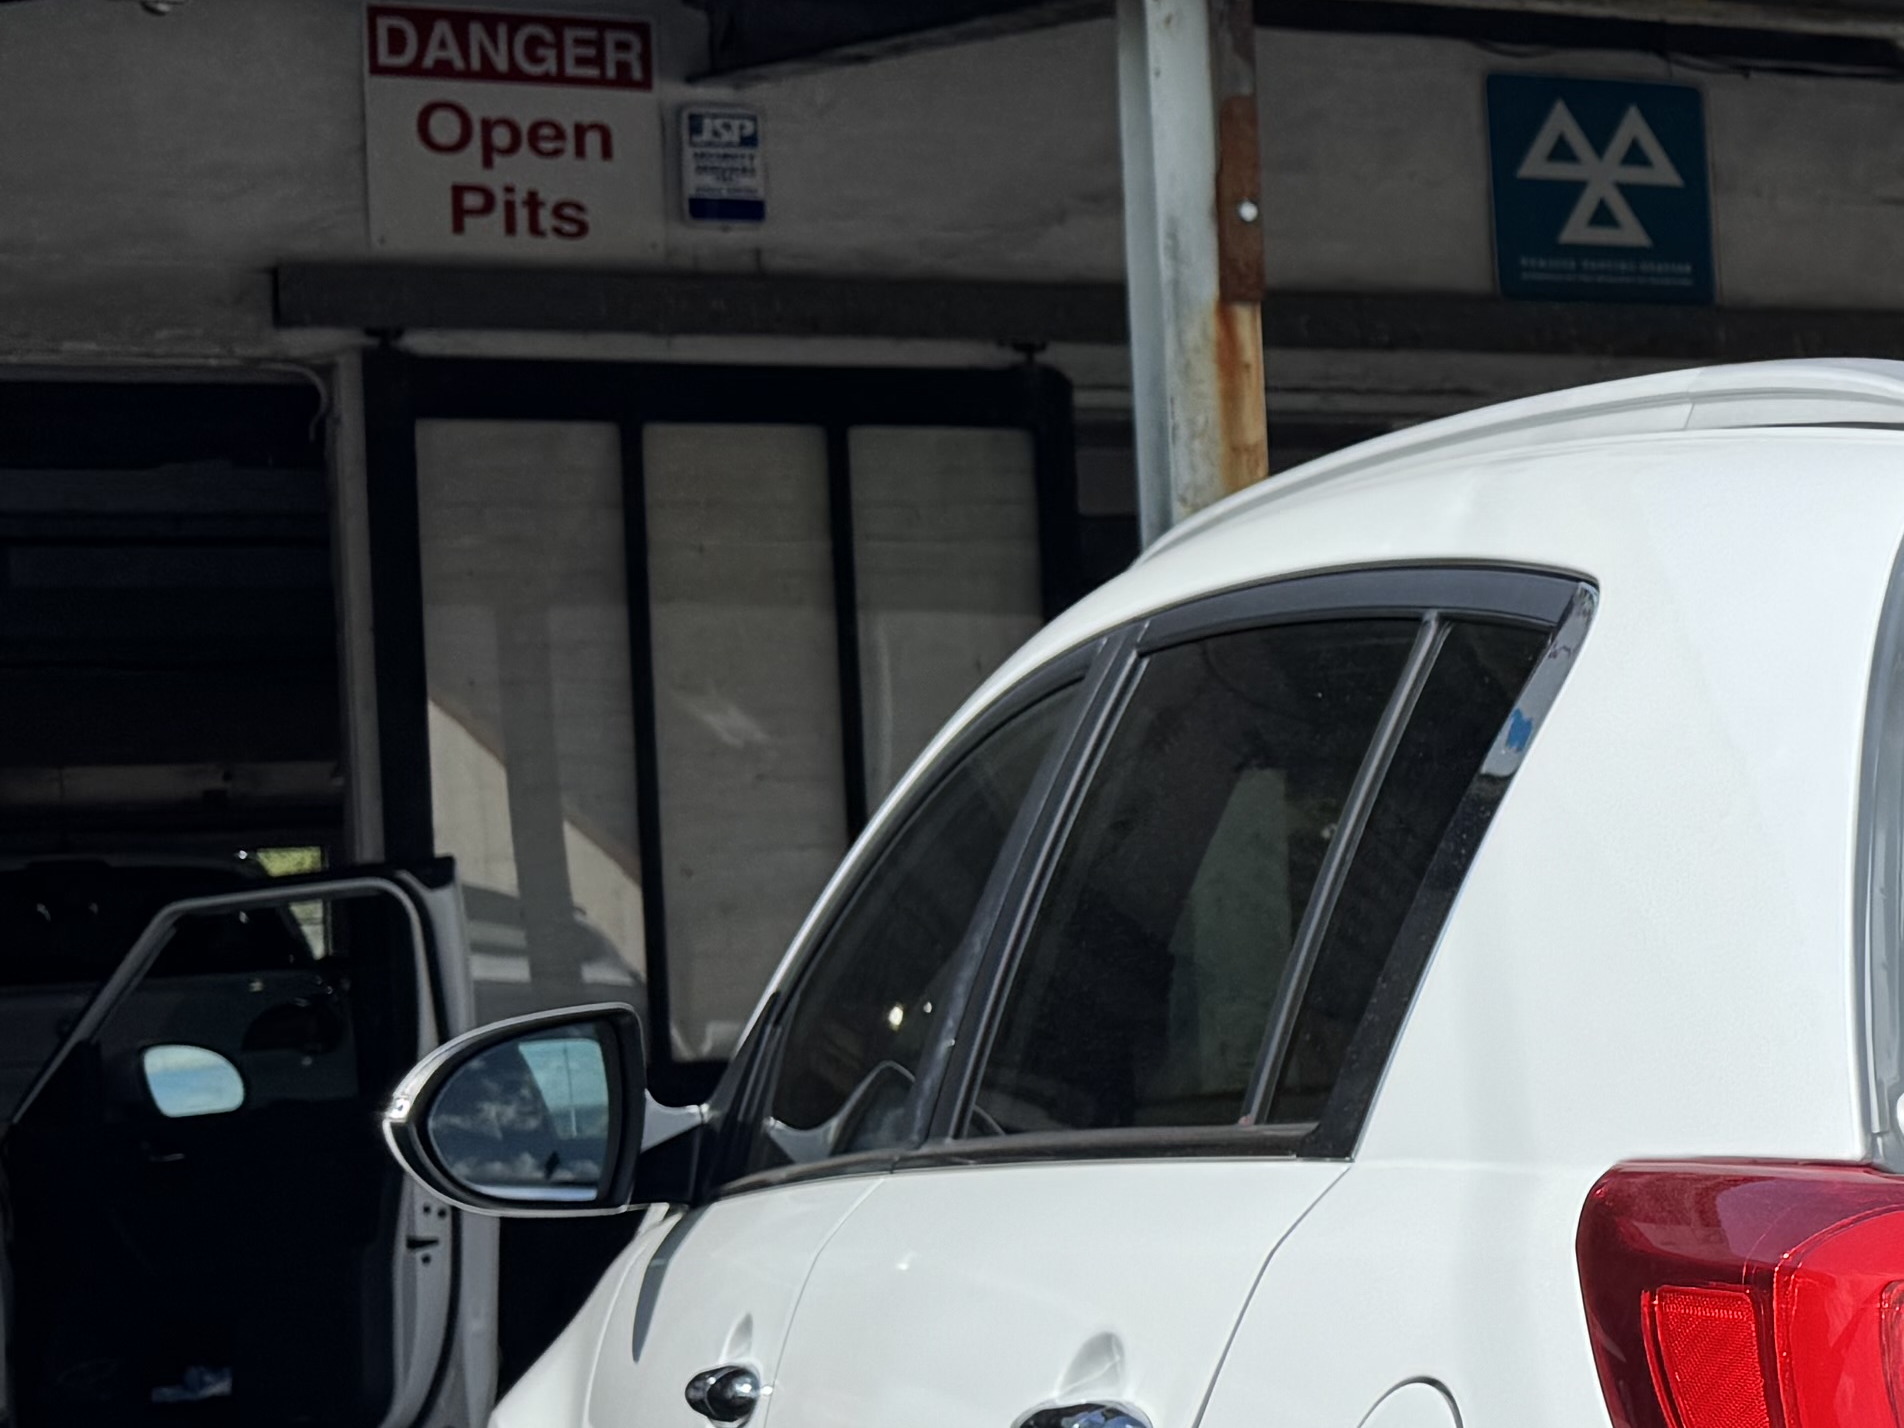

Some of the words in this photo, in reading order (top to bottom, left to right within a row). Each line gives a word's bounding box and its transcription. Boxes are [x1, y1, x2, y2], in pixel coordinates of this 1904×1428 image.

[374, 15, 644, 82] DANGER
[416, 100, 614, 169] Open
[450, 184, 590, 241] Pits
